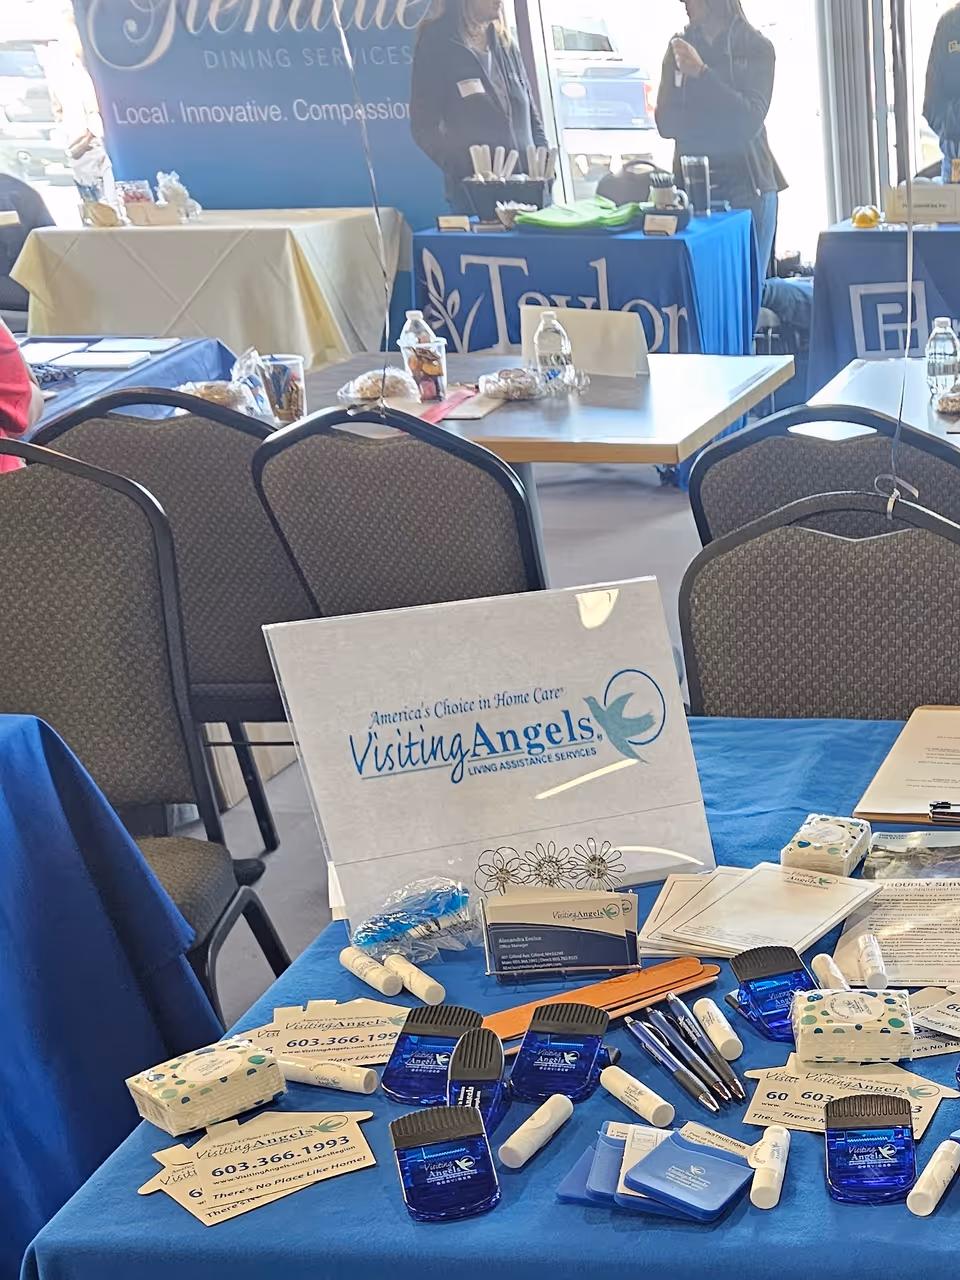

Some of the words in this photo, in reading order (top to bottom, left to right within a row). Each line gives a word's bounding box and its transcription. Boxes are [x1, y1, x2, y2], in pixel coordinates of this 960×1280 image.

[204, 48, 292, 70] DINING
[303, 46, 414, 67] SERVICES
[112, 101, 176, 126] Local.
[181, 100, 288, 124] Innovative.
[460, 255, 687, 353] Tlor
[368, 702, 430, 729] America's
[434, 697, 475, 719] Choice
[479, 694, 491, 709] in
[493, 690, 530, 709] Home
[467, 764, 498, 776] LIVING
[499, 753, 552, 771] ASSISTANCE
[555, 747, 597, 762] SERVICES
[752, 1112, 773, 1121] The
[705, 1130, 746, 1150] INSTRUCTIONS
[210, 1135, 350, 1177] 603.366.1993
[850, 1152, 883, 1161] Angels
[213, 1186, 254, 1200] There's
[256, 1181, 273, 1190] No
[274, 1173, 305, 1187] Place
[306, 1165, 329, 1178] Like
[330, 1155, 366, 1171] Home!
